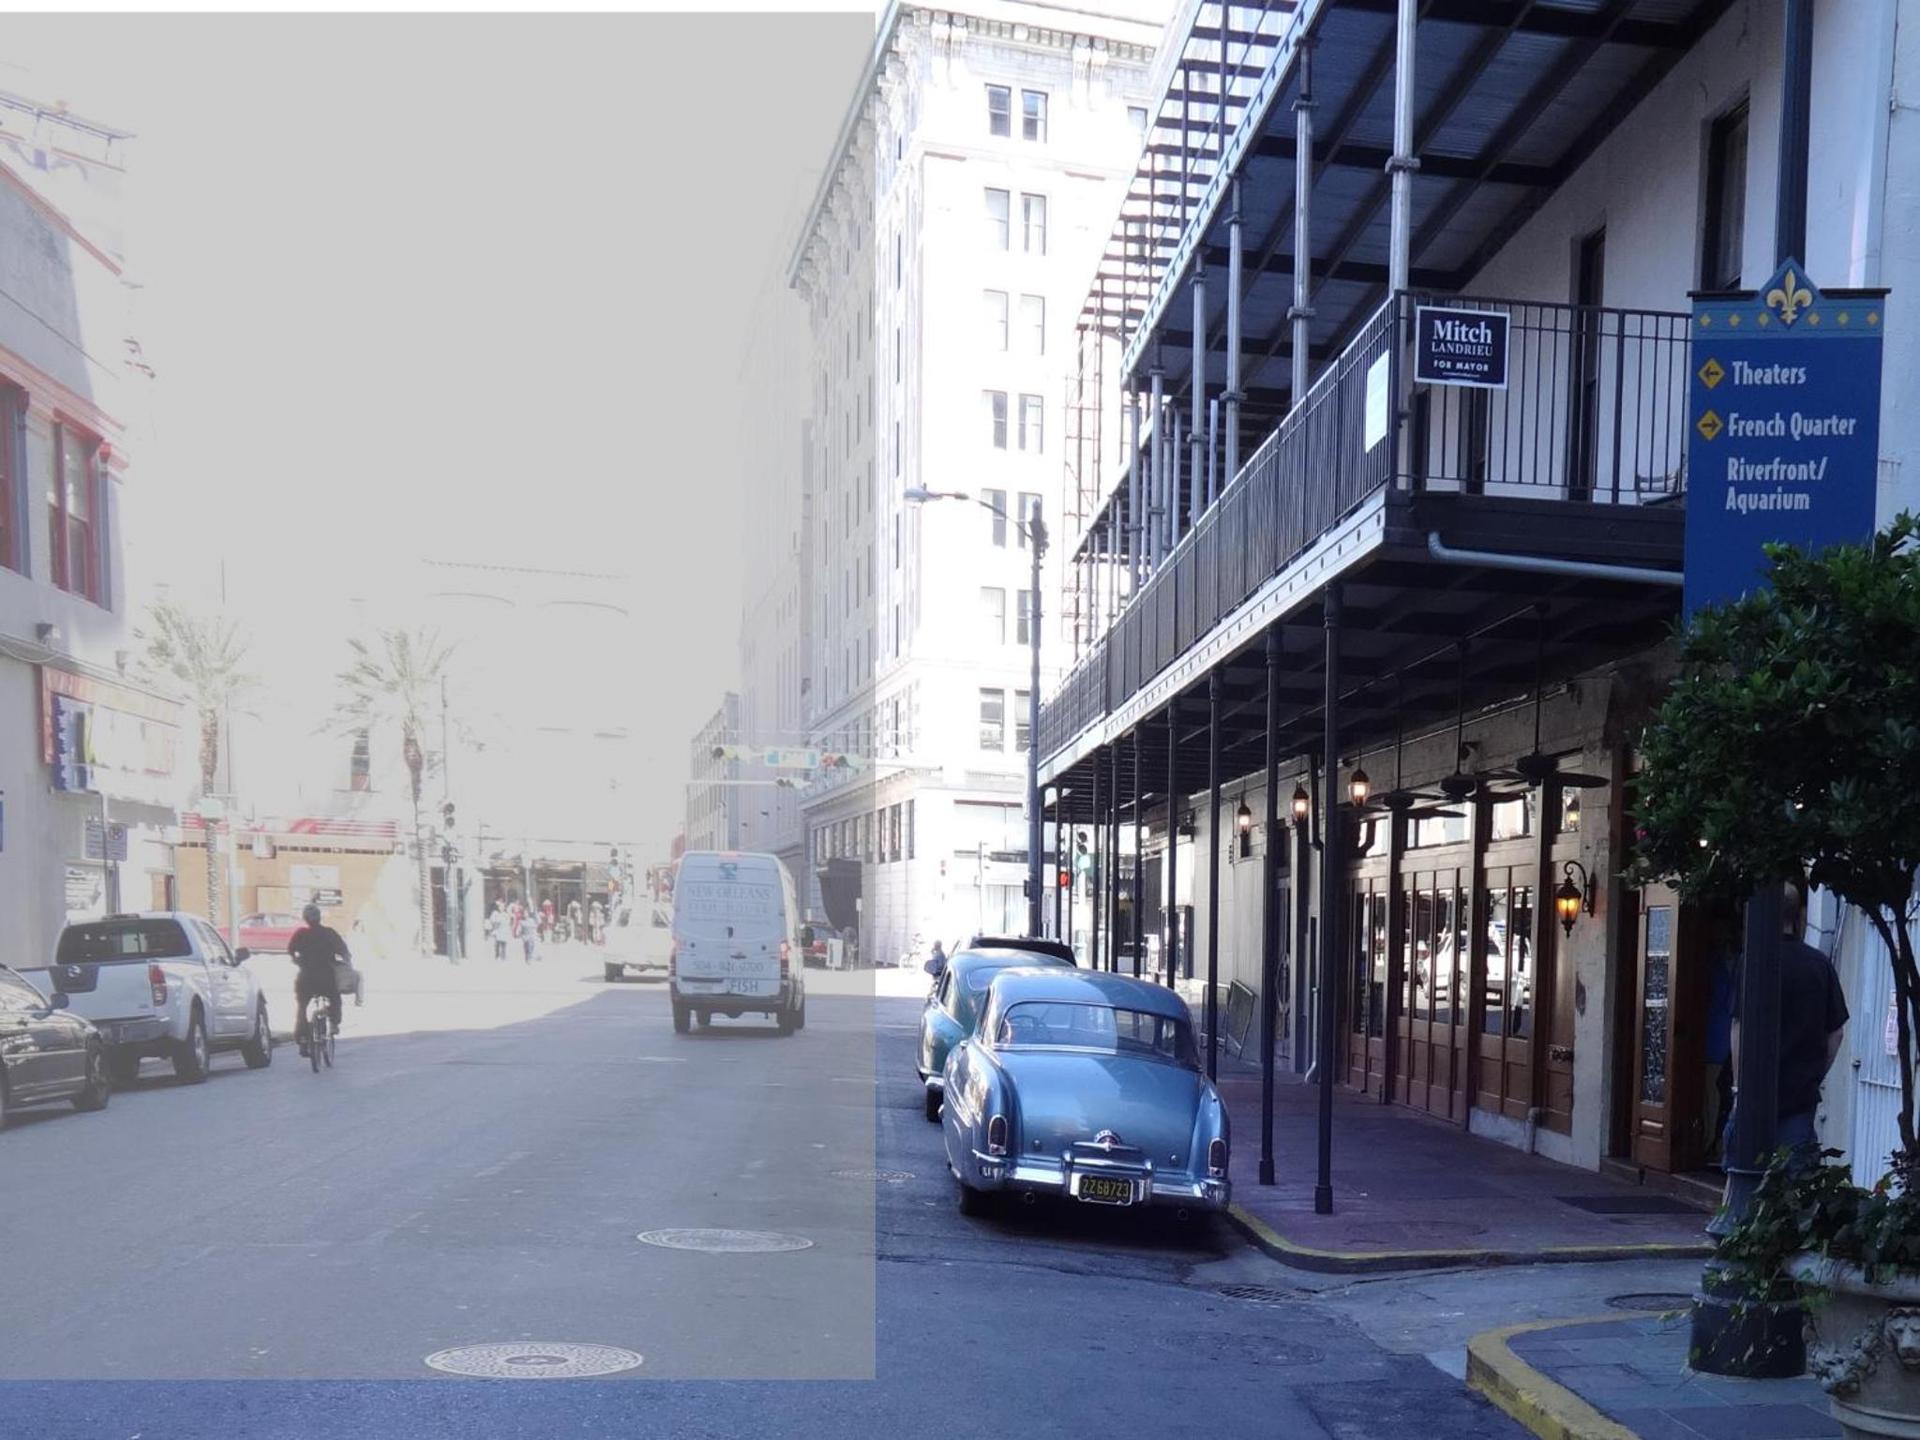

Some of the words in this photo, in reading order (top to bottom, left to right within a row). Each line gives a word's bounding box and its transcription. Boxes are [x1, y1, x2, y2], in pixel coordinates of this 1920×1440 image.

[1432, 319, 1493, 344] Mitch
[1431, 341, 1493, 357] LANDRIEU
[1433, 359, 1452, 369] FOR
[1456, 362, 1489, 372] MAYOR
[1732, 360, 1807, 385] Theaters
[1728, 412, 1786, 437] French
[1790, 412, 1857, 441] Quarter
[1727, 456, 1829, 481] Riverfront/
[1726, 486, 1810, 515] Aquarium
